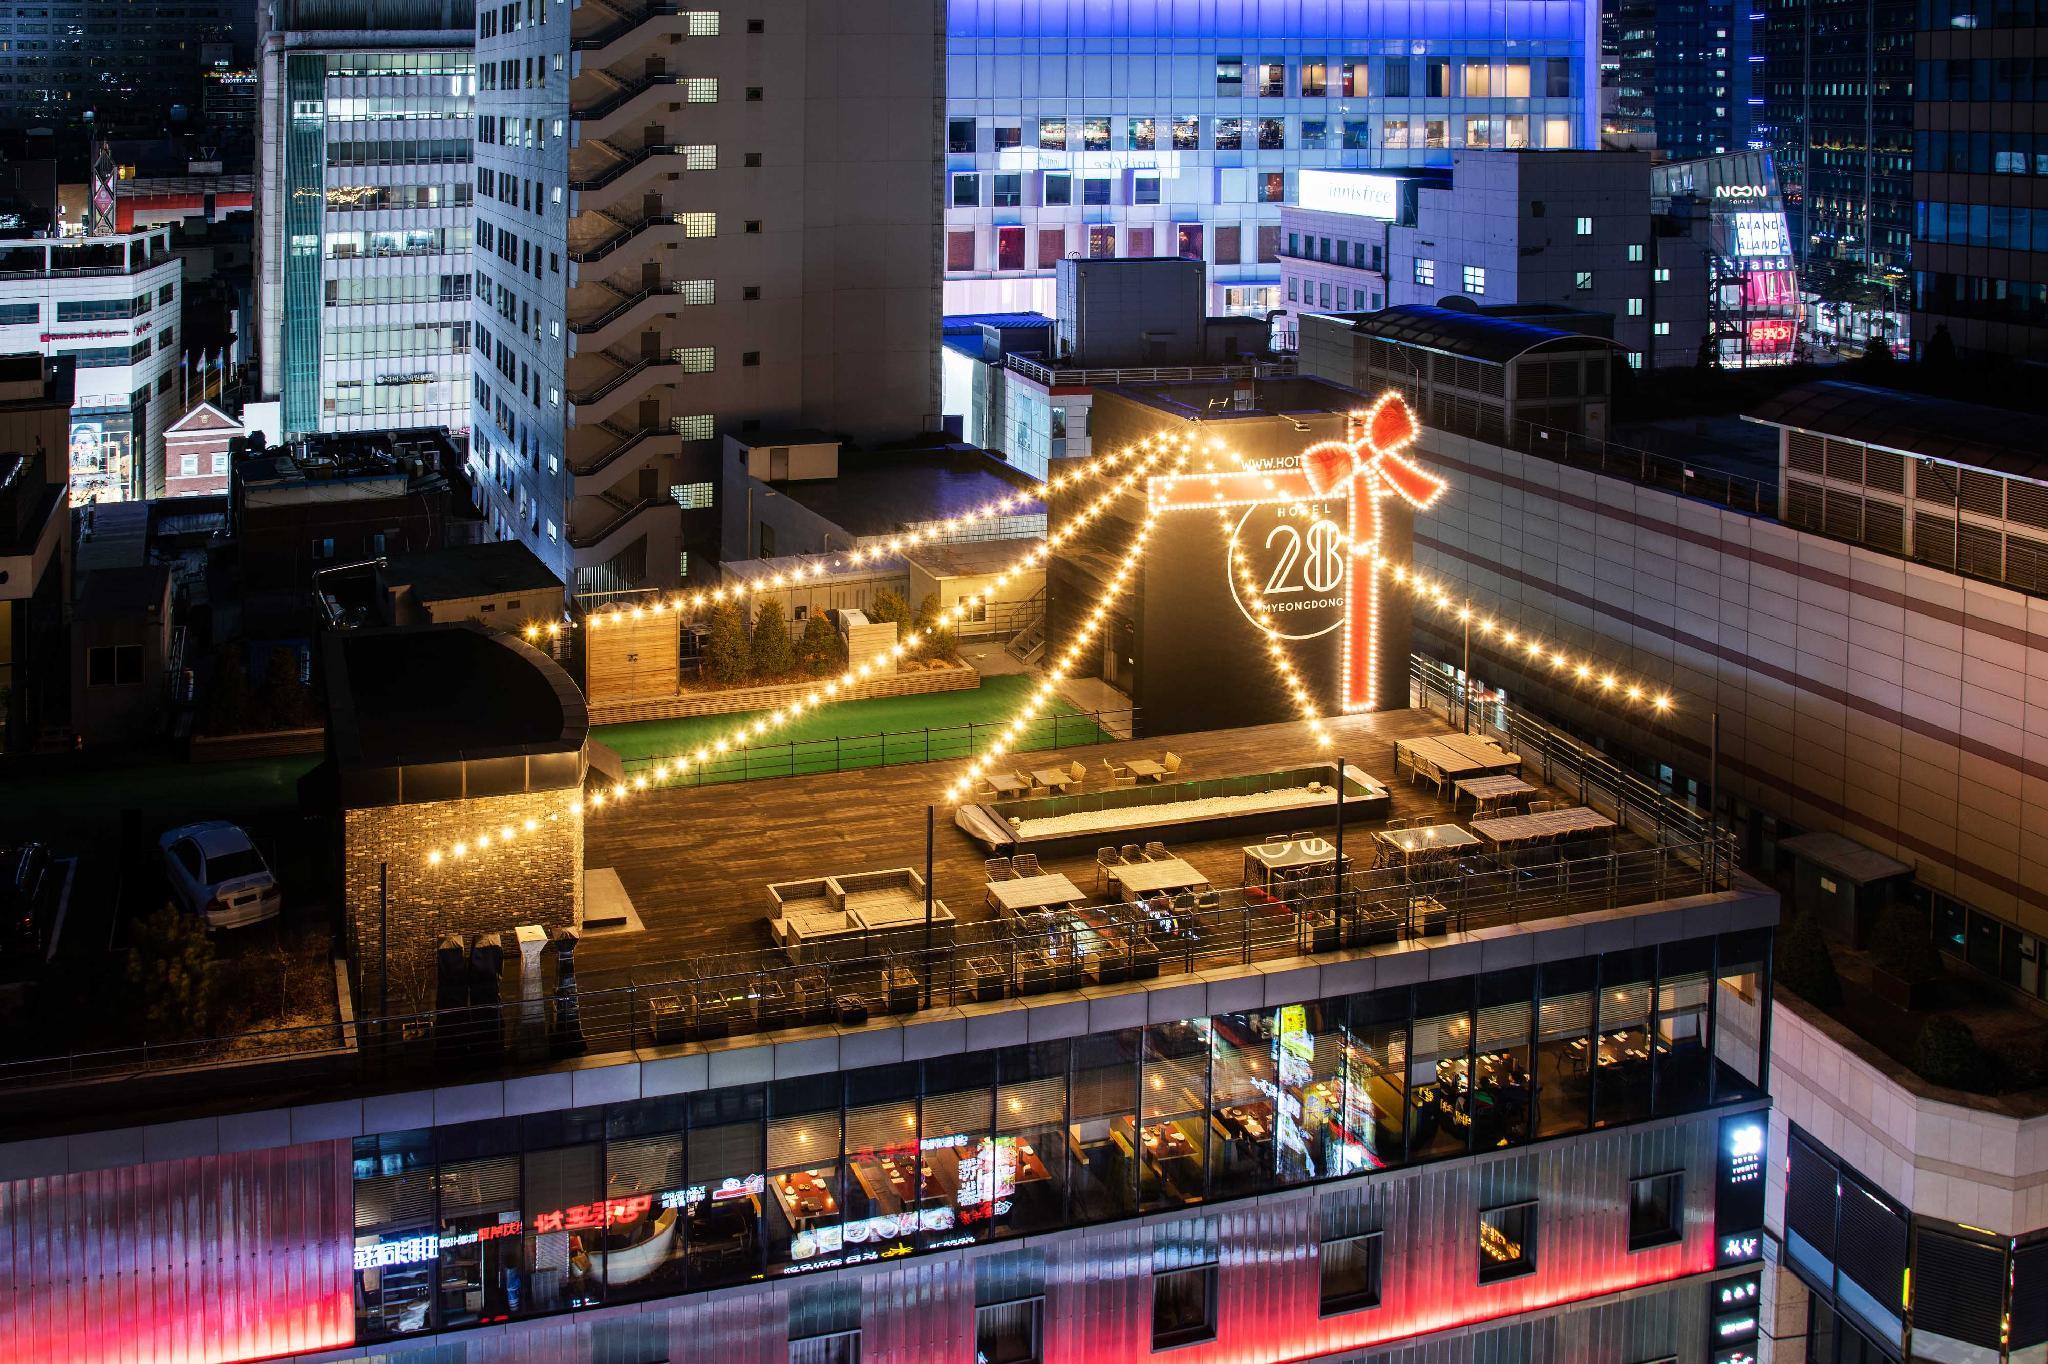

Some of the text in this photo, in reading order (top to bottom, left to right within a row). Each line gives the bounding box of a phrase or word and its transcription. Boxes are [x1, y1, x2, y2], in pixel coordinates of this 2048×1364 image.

[1328, 183, 1393, 204] innisfree
[1715, 185, 1767, 198] NOON
[1240, 454, 1301, 472] WWW.HOT
[1277, 503, 1332, 518] HOEL
[1263, 519, 1345, 595] 28
[1262, 597, 1345, 613] MYEONGDONG
